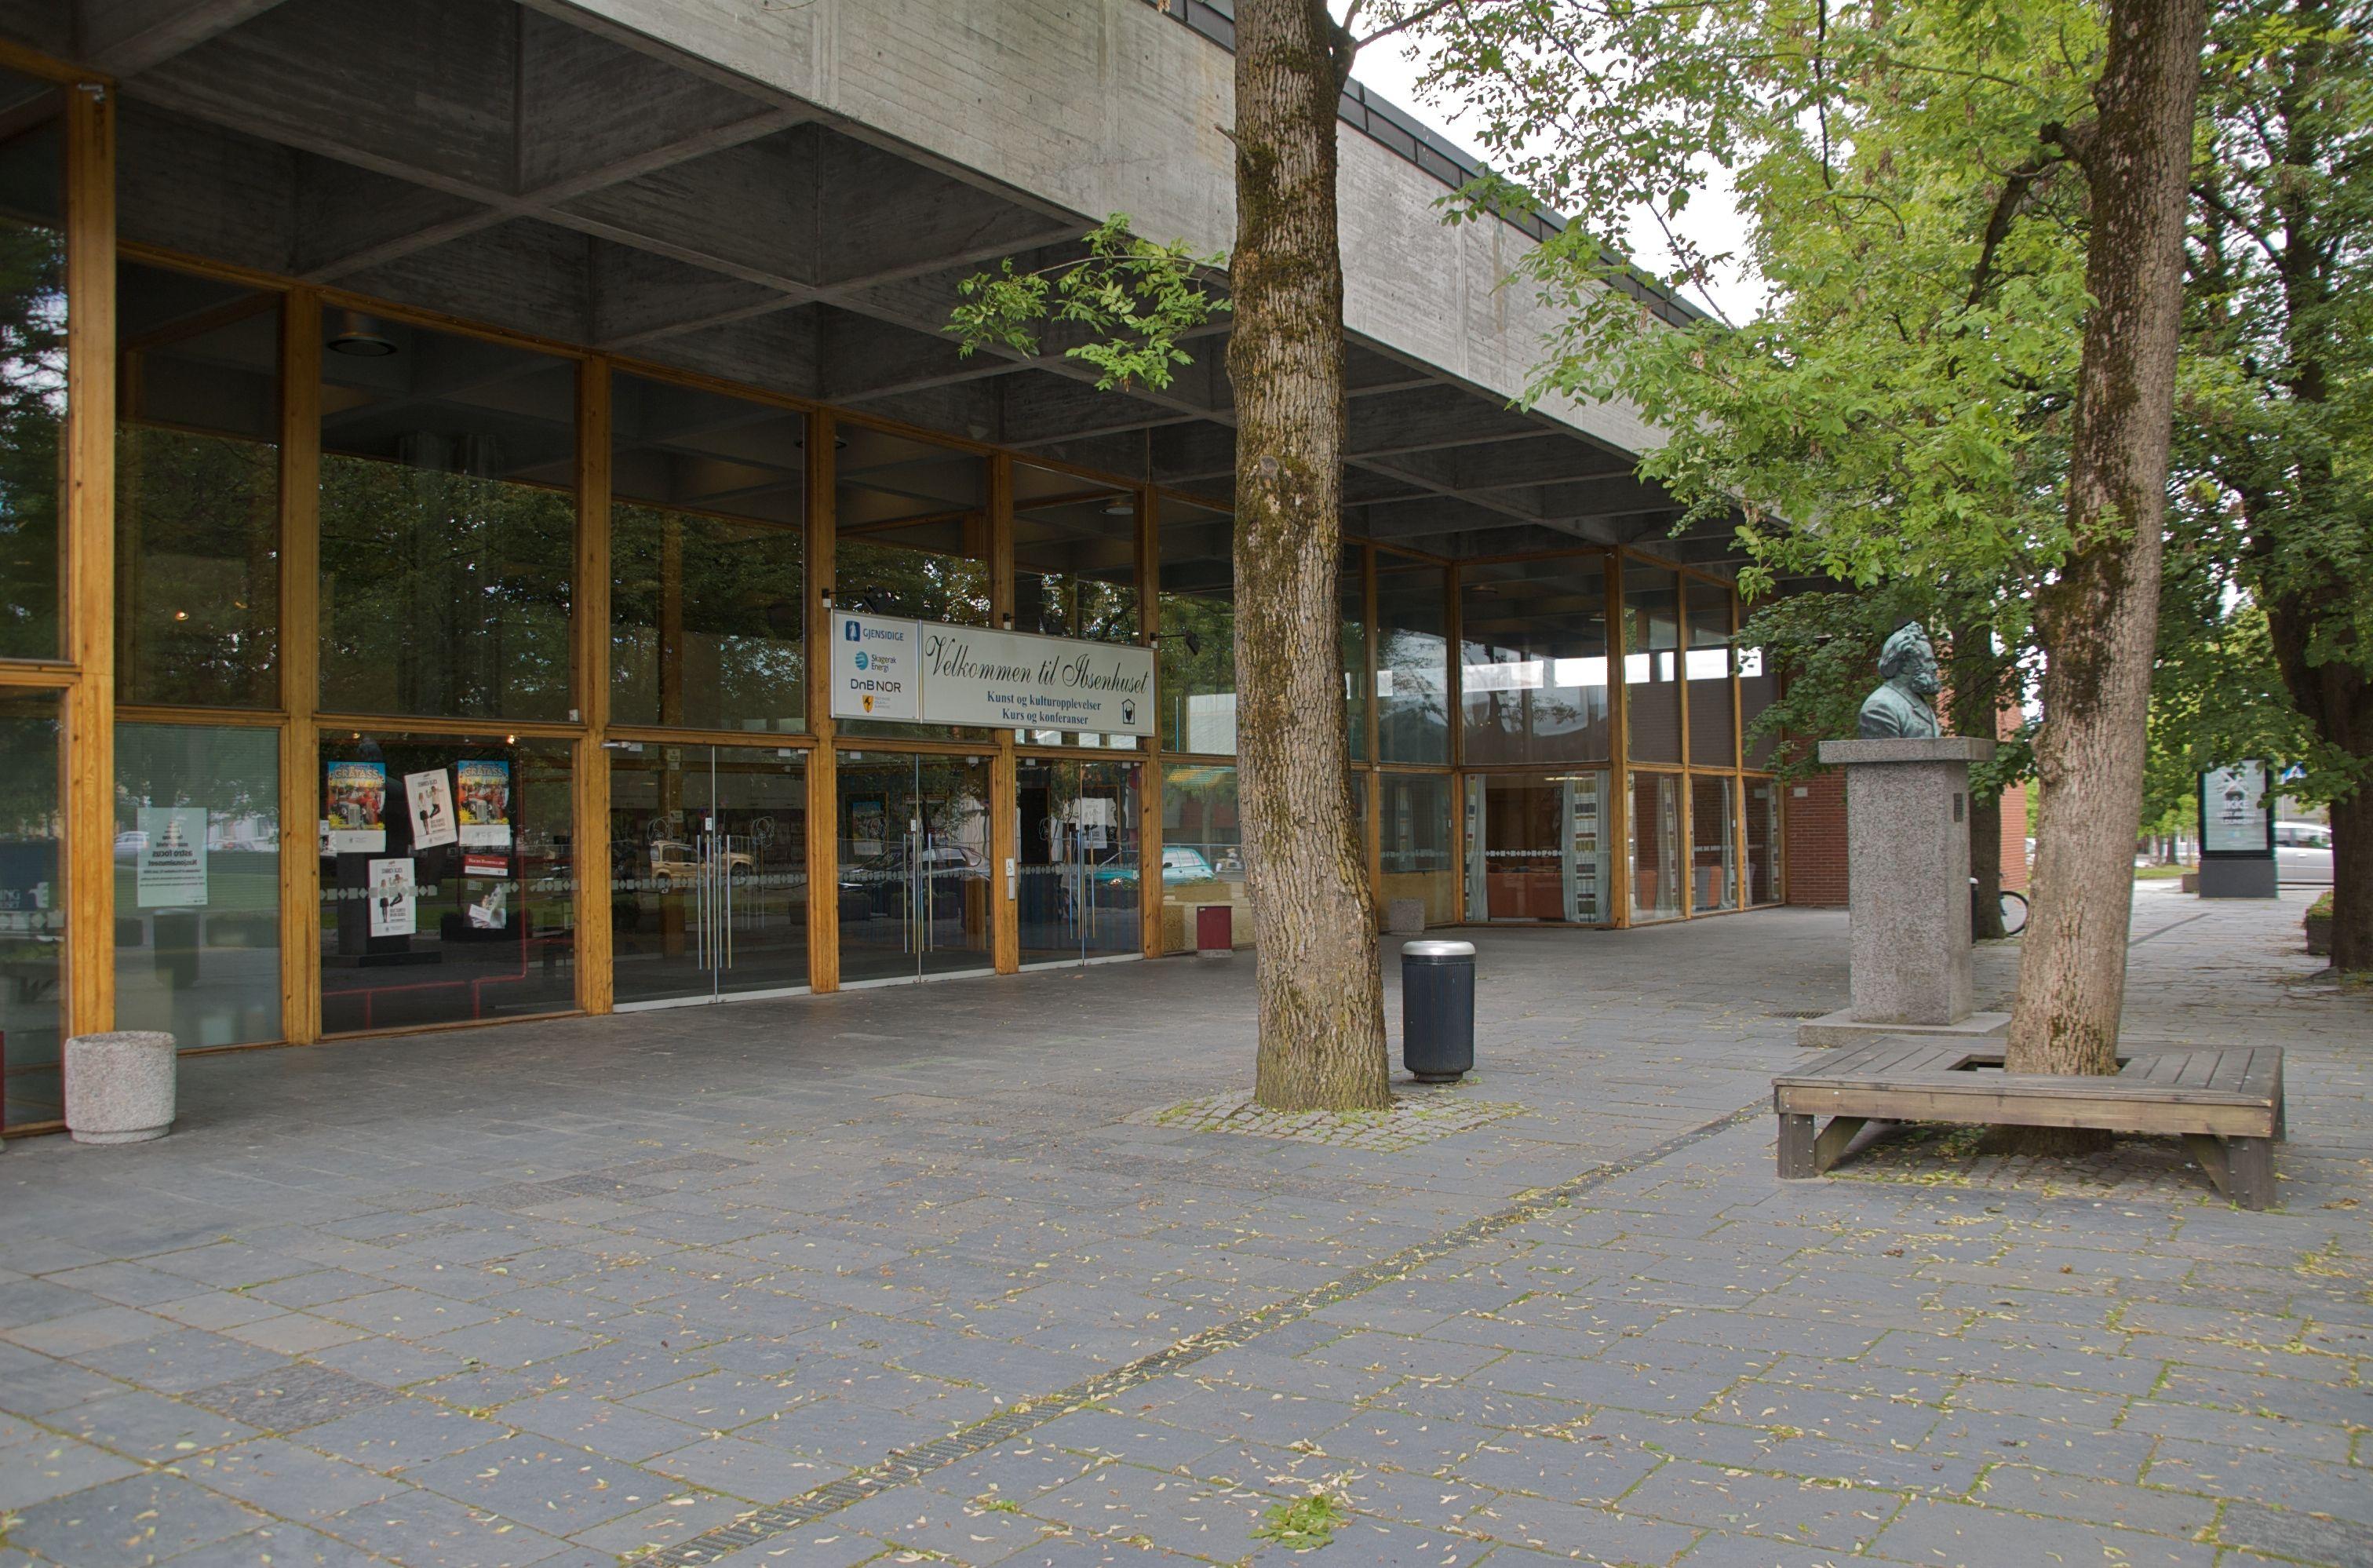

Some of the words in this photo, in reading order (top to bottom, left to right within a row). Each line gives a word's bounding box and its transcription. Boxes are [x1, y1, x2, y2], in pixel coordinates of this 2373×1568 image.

[863, 629, 904, 641] GJENSIDIGE
[871, 655, 897, 665] Skagerak
[925, 635, 1033, 684] Velkommen
[1038, 655, 1060, 685] til
[1063, 654, 1150, 694] Ibsenhuset
[871, 662, 889, 673] Energi
[851, 679, 875, 690] DnB
[876, 681, 902, 693] NOR
[987, 691, 1015, 704] Kunst
[1017, 696, 1027, 706] og
[1030, 694, 1102, 712] kulturopplevelser
[1002, 708, 1025, 720] Kurs
[1026, 713, 1037, 724] og
[1039, 711, 1088, 725] konferanser
